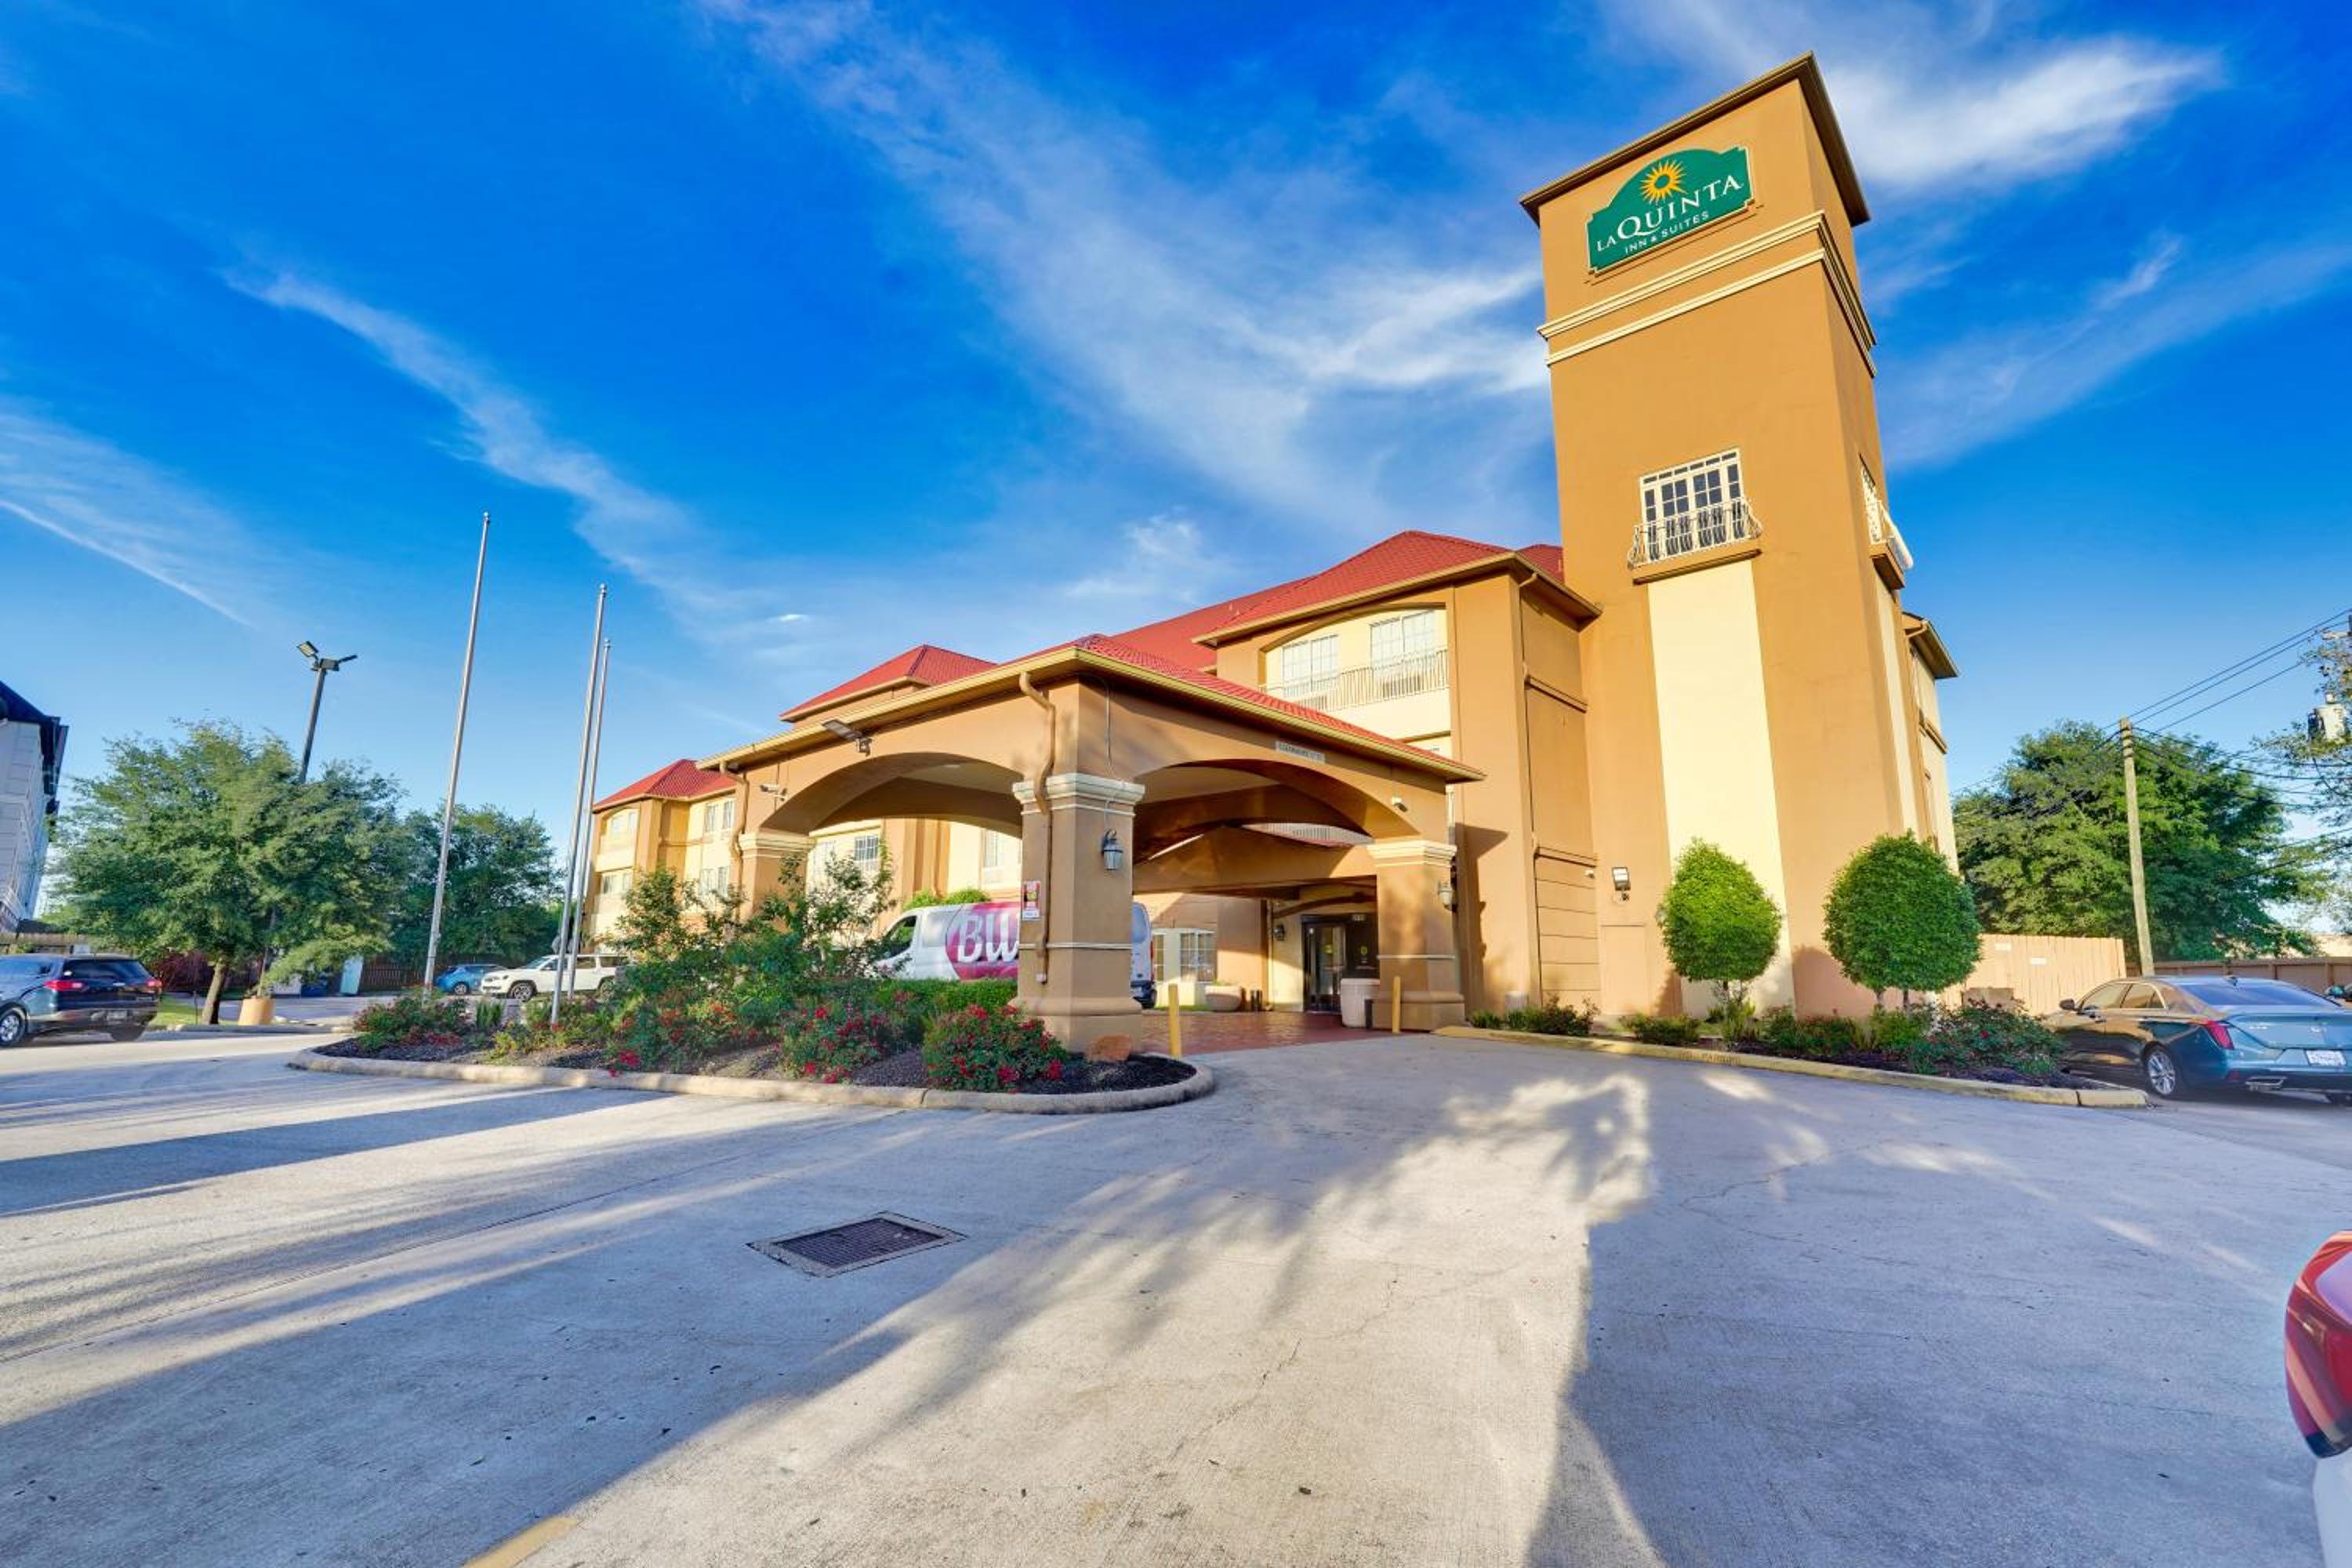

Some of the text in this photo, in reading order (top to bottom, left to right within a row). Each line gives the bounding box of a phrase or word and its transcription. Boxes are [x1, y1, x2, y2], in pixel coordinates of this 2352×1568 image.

[1597, 175, 1743, 252] LA QUINTA
[1625, 238, 1647, 254] INN
[1661, 210, 1709, 238] SUITES
